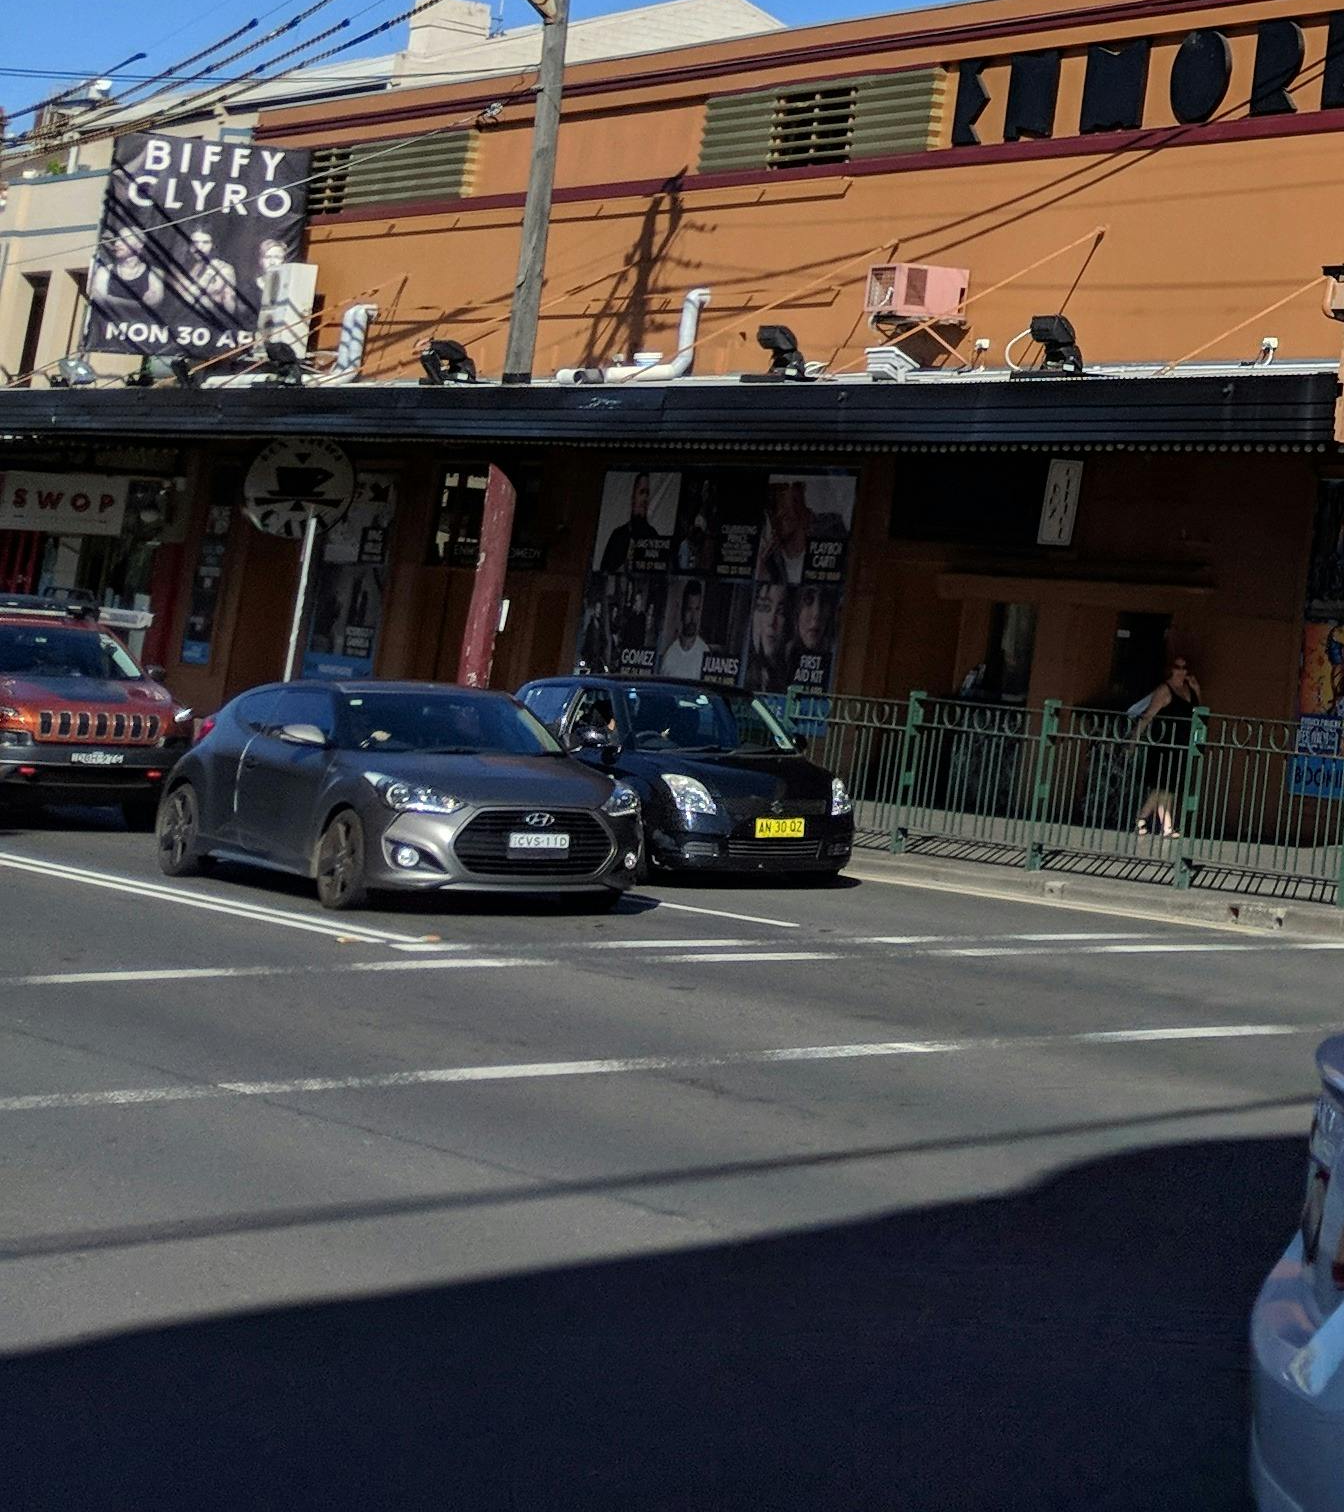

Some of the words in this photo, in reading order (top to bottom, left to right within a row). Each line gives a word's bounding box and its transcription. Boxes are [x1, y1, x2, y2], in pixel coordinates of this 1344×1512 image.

[145, 139, 286, 181] BIFFY
[128, 175, 292, 218] CLYRO
[105, 321, 168, 344] MON
[176, 326, 211, 347] 30
[216, 330, 256, 348] AP
[12, 488, 114, 512] SWOP
[621, 648, 655, 666] GOMEZ
[758, 821, 772, 834] AN
